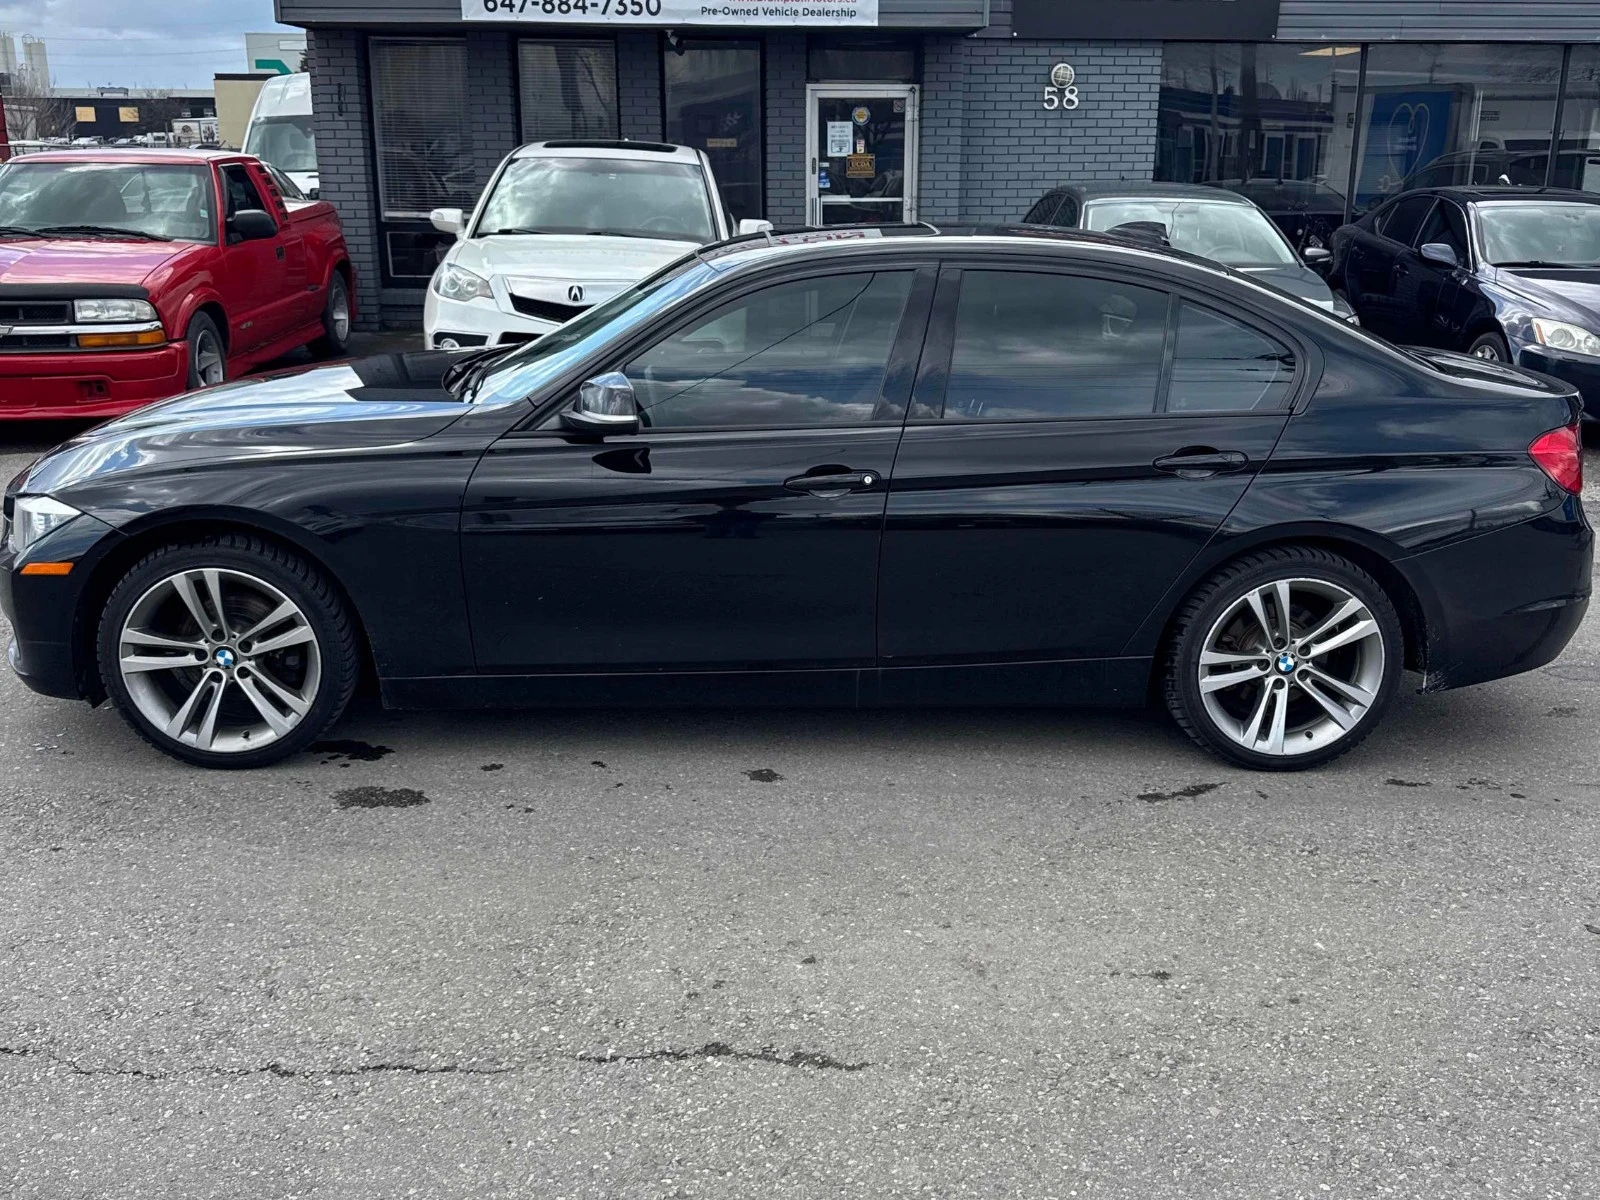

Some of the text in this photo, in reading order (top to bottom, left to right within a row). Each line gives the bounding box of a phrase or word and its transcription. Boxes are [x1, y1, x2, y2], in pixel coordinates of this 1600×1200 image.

[701, 6, 857, 18] Pre-Owned Vehicle Dealership
[1043, 86, 1079, 110] 58
